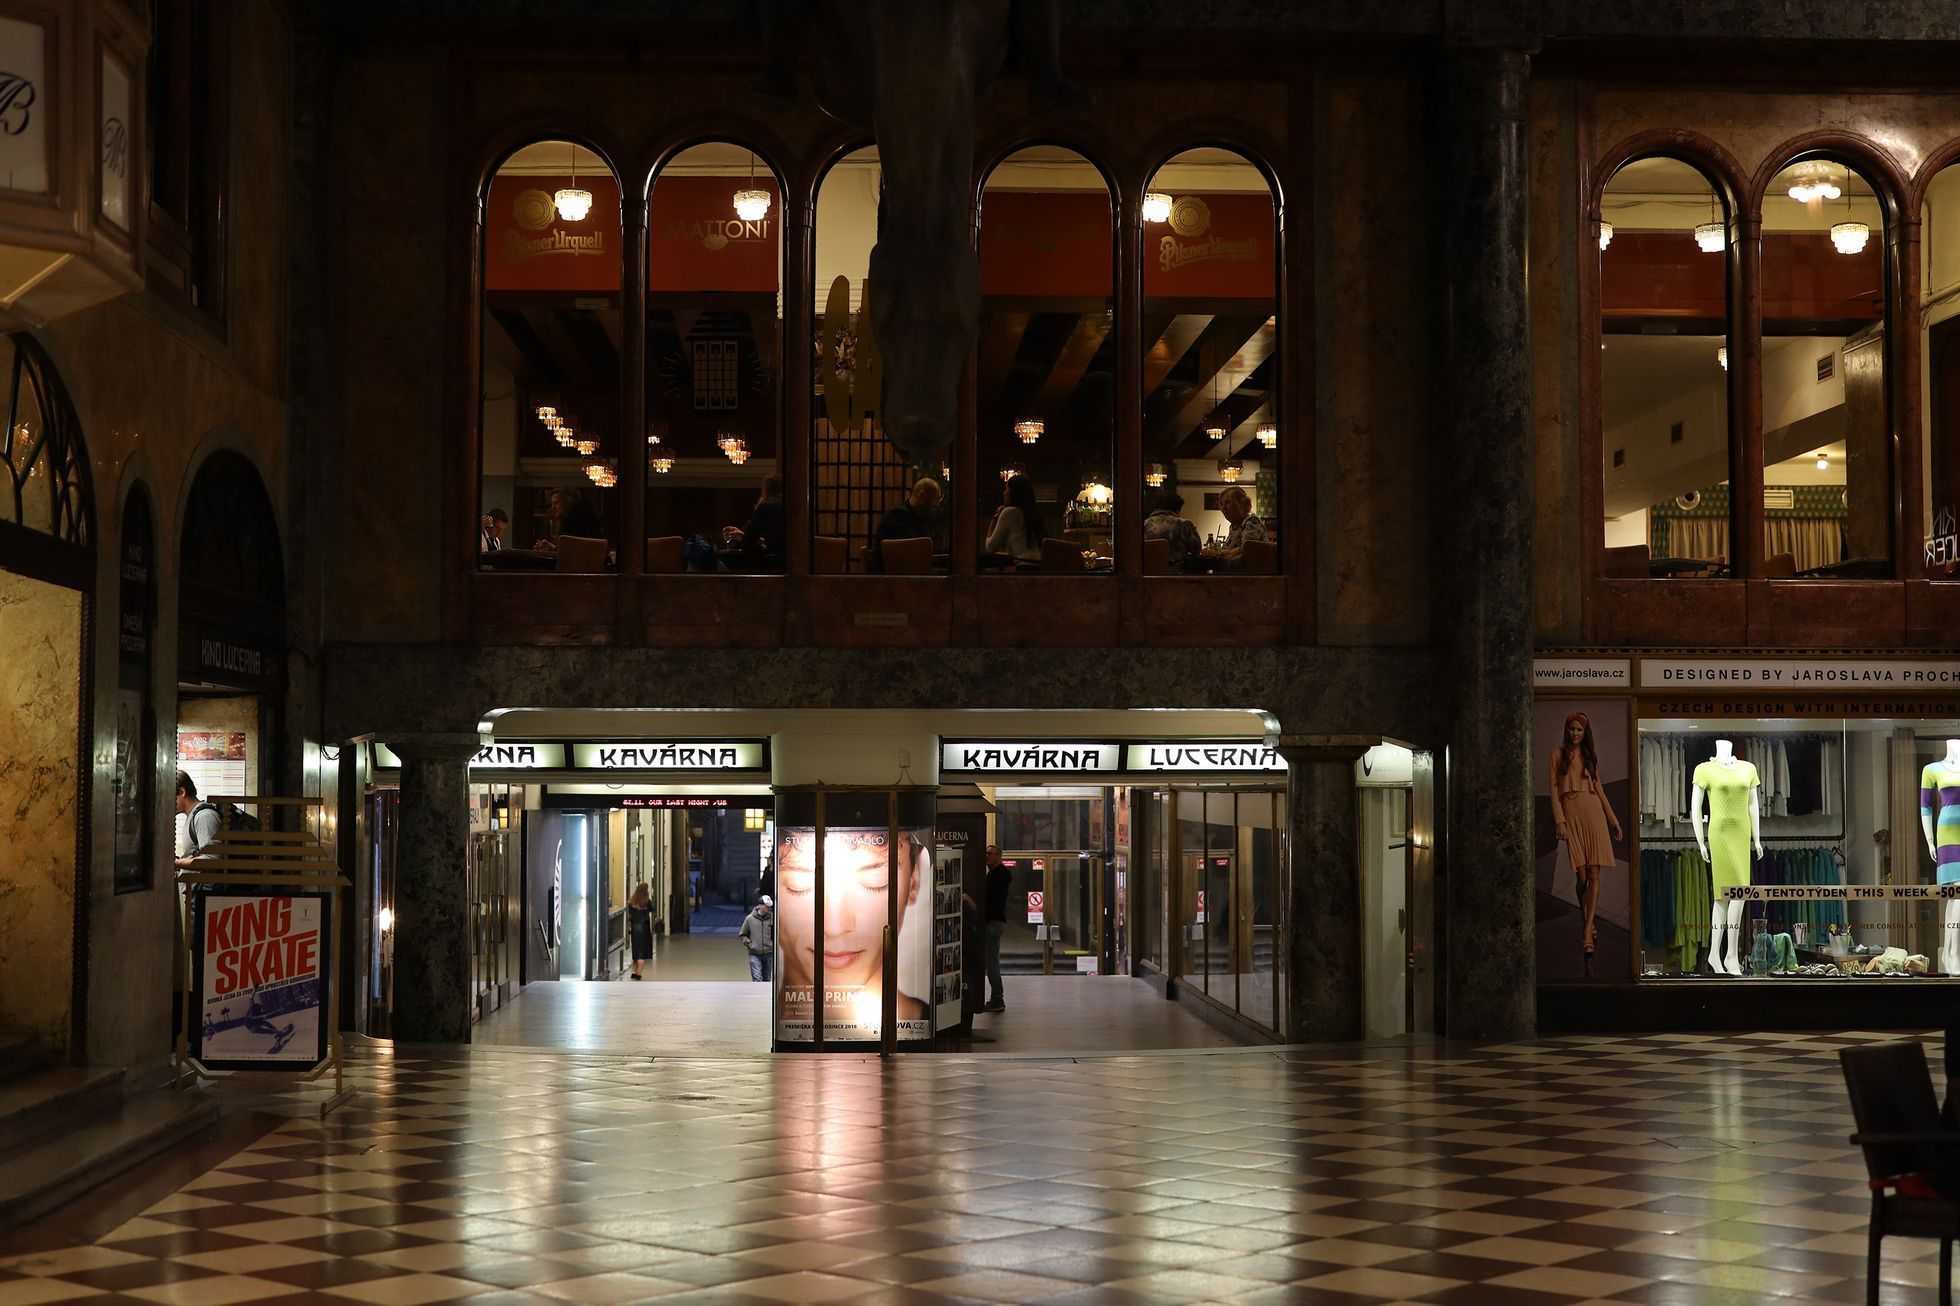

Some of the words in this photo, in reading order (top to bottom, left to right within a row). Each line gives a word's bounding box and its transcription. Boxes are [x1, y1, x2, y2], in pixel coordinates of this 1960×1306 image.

[665, 219, 769, 239] MATTONI
[553, 228, 603, 256] Urquell
[1159, 235, 1211, 272] Pilsner
[201, 639, 221, 667] KINO
[223, 643, 261, 675] LUCERNA
[1535, 667, 1624, 680] www.jaroslava.cz
[1663, 669, 1753, 681] DESIGNED
[1762, 669, 1783, 681] BY
[1792, 669, 1894, 681] JAROSLAVA
[1659, 703, 1714, 714] CZECH
[1723, 703, 1786, 714] DESIGN
[1794, 703, 1836, 714] WITH
[1844, 703, 1960, 715] INTERNATION
[600, 743, 737, 766] KAVÁRNA
[963, 746, 1099, 768] KAVÁRNA
[1149, 748, 1277, 766] LUCERNA
[1724, 887, 1760, 899] -50%
[1764, 888, 1805, 898] TENTO
[1807, 886, 1848, 898] TÝDEN
[1854, 888, 1884, 898] THIS
[1893, 888, 1929, 898] WEEK
[207, 896, 292, 954] KING
[215, 929, 318, 995] SKATE
[785, 991, 815, 1002] MAL
[825, 991, 865, 1002] PRIN
